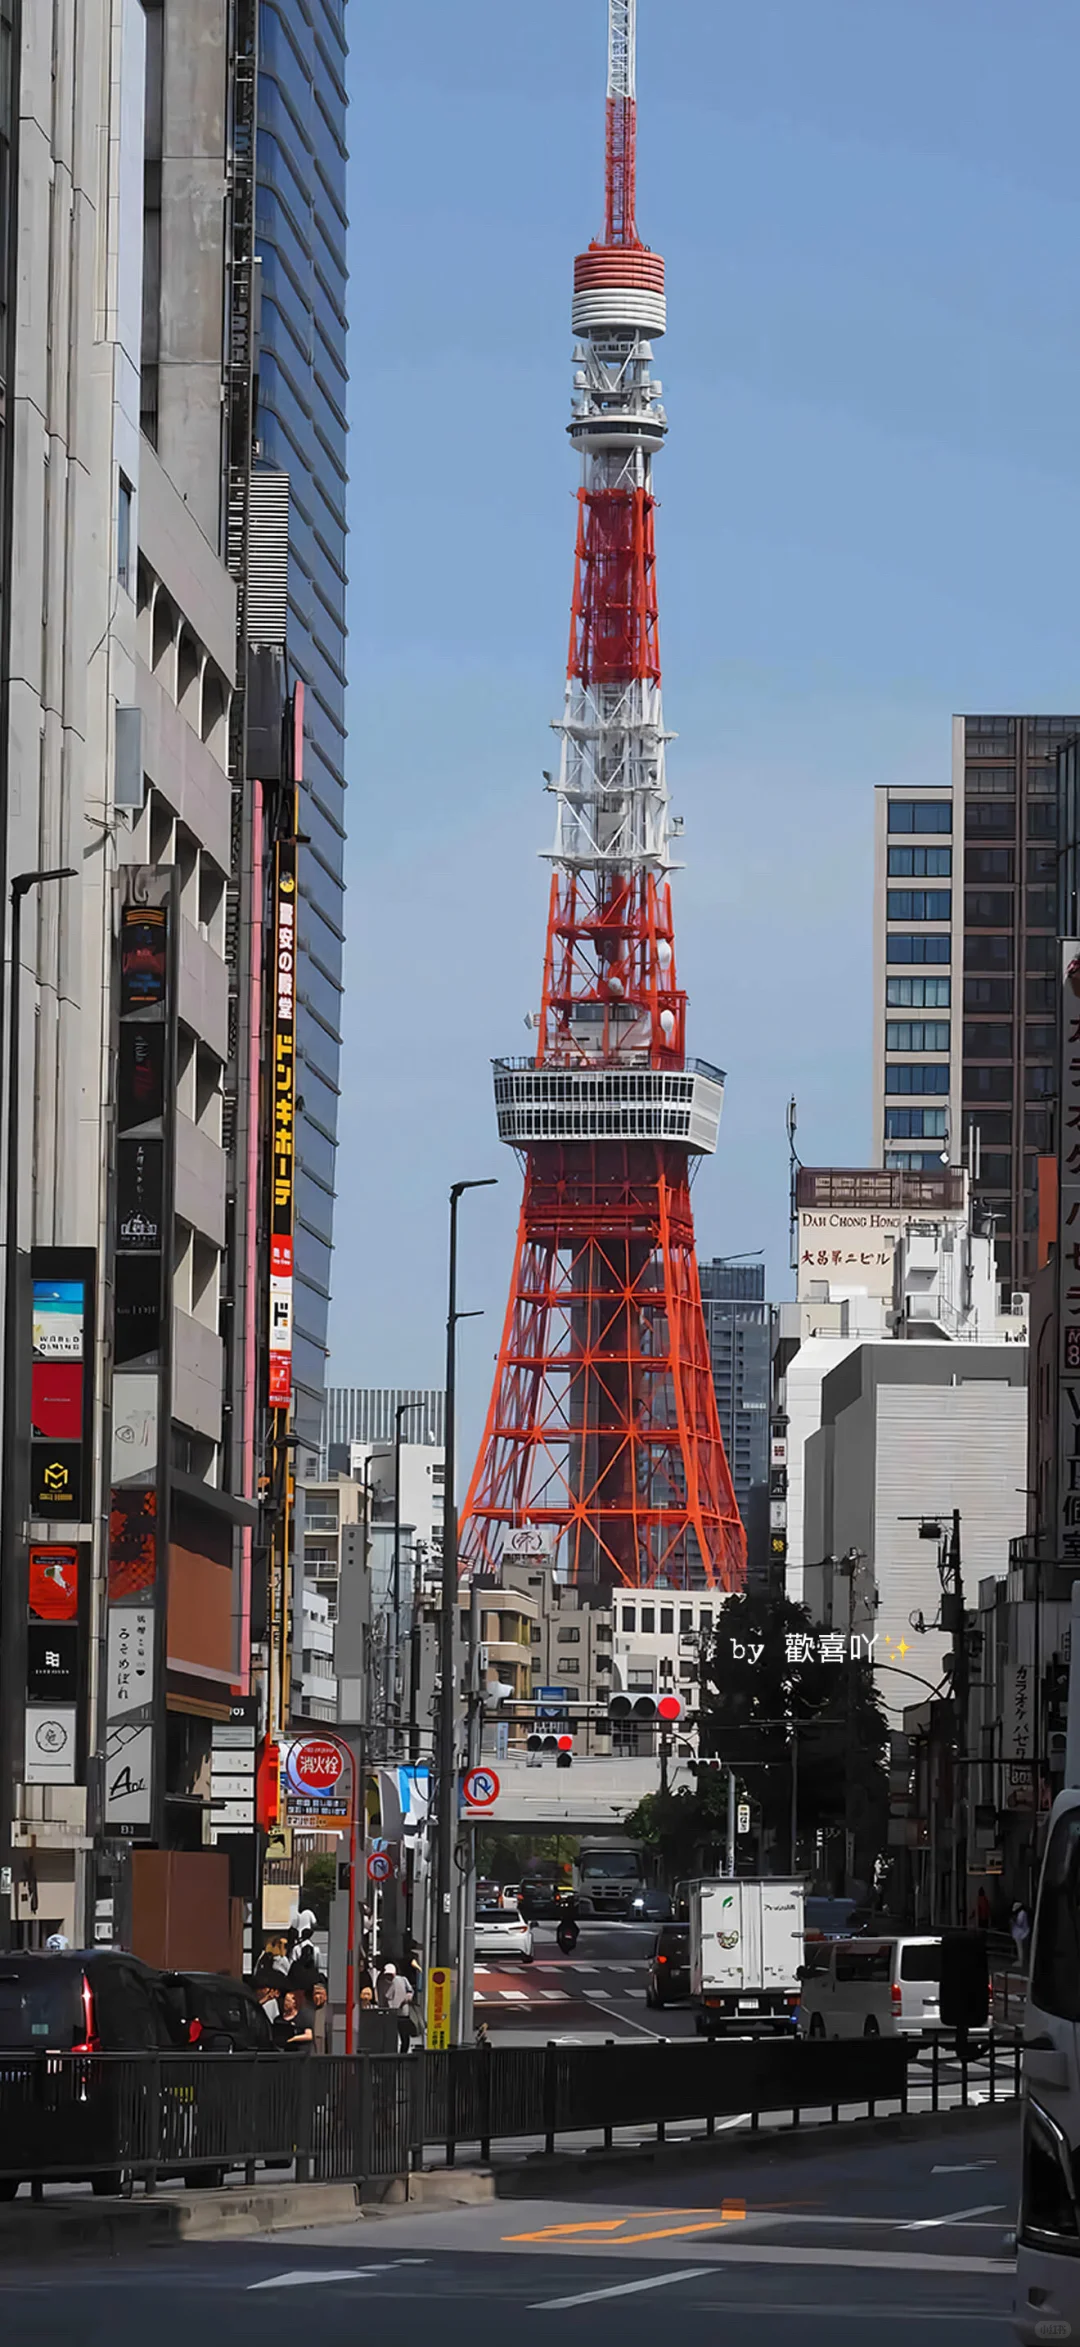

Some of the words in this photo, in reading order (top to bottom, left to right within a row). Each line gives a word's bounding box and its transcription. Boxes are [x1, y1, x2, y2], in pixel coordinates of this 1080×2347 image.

[830, 1214, 867, 1228] CHONG
[300, 1755, 339, 1775] 消火栓
